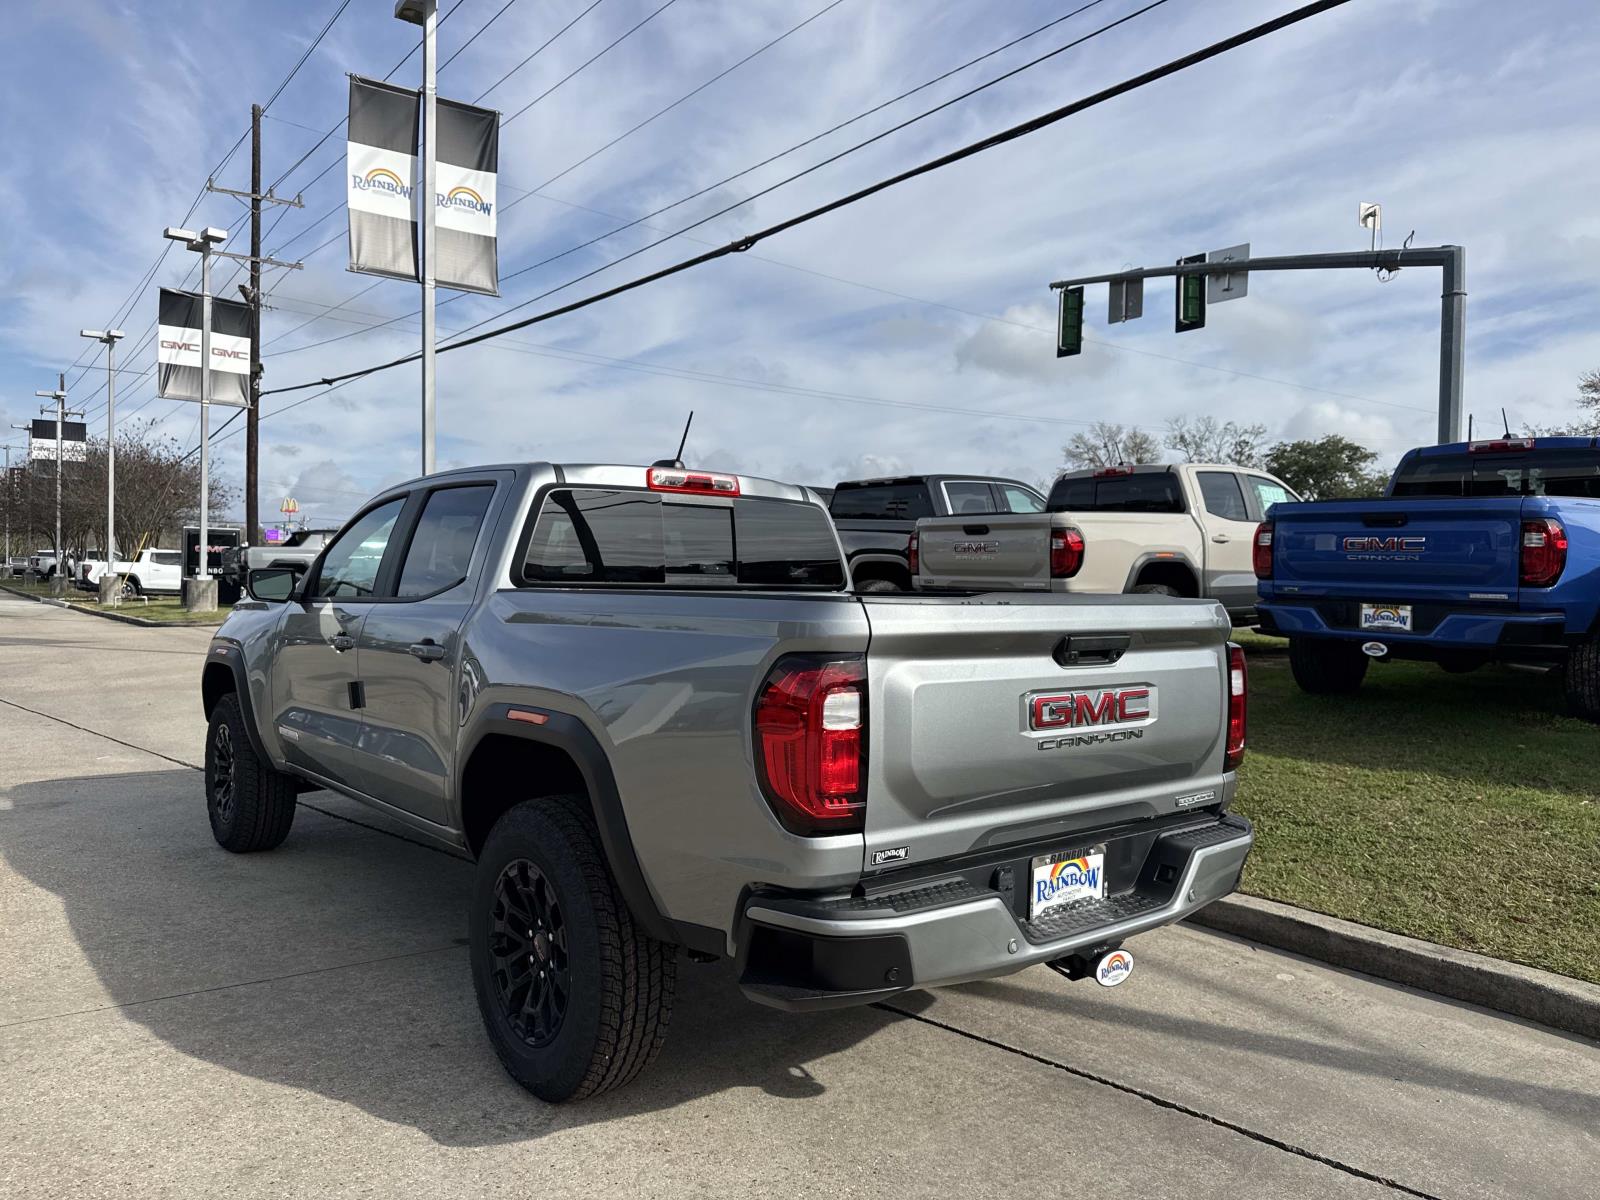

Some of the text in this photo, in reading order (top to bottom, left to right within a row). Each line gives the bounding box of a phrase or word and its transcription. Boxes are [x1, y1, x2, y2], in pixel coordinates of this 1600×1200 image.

[352, 174, 413, 200] RAINBOW
[435, 192, 493, 216] RAINBOW
[160, 340, 201, 352] GMC
[211, 347, 249, 360] GMC
[954, 542, 999, 553] GMC
[1343, 536, 1426, 552] GMC
[1364, 613, 1409, 626] RAINBOW
[1029, 687, 1151, 732] GMC
[1037, 728, 1144, 751] CANYON
[876, 847, 906, 864] RAINBOW
[1037, 865, 1101, 904] RAINBOW
[1101, 960, 1131, 980] RAINBOW
